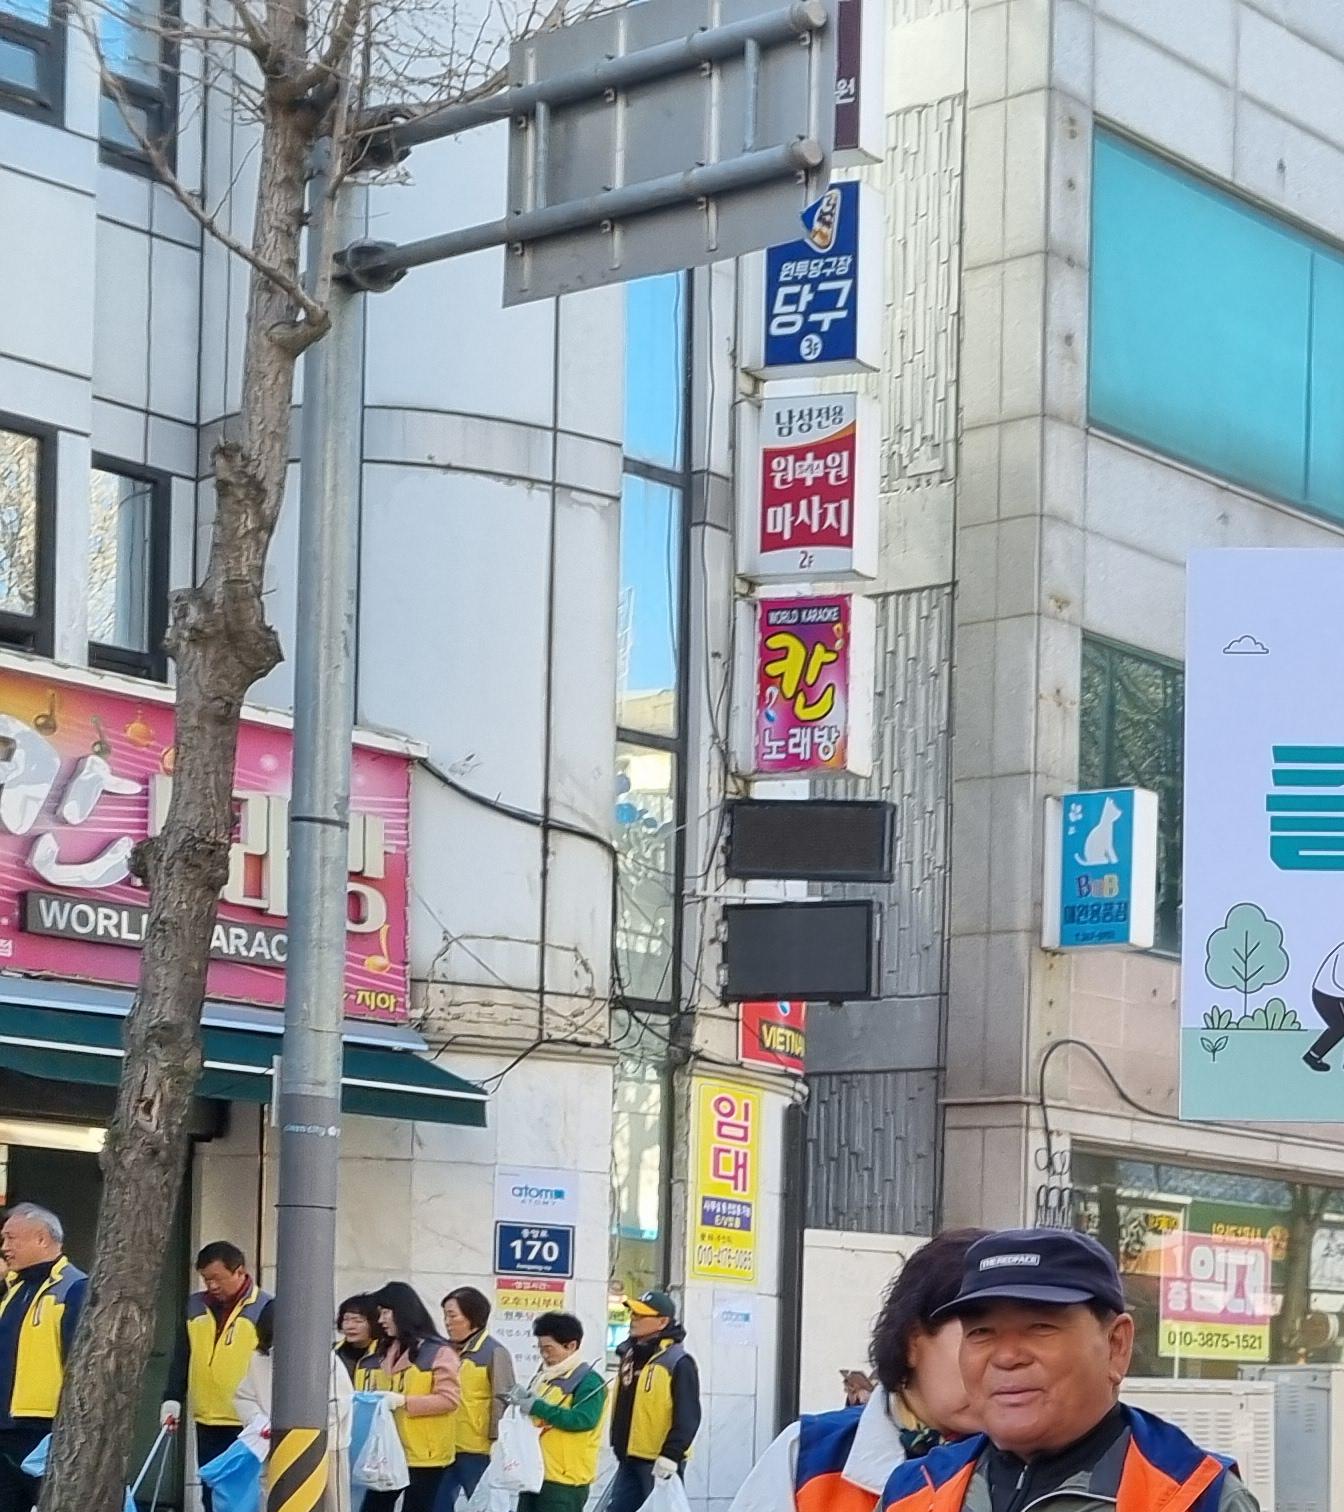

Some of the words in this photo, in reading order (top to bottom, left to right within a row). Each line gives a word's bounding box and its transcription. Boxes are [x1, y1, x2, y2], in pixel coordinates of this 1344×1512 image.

[779, 256, 851, 282] 원투당구장
[769, 279, 853, 336] 당구
[775, 404, 845, 437] 남성전용
[766, 495, 850, 541] 마사지
[799, 550, 815, 569] 2F
[767, 610, 798, 625] WORLD
[765, 631, 838, 721] 칸
[762, 726, 840, 763] 노래방
[38, 898, 151, 942] WORL
[712, 1095, 751, 1194] 임대
[510, 1240, 559, 1263] 170
[1167, 1323, 1263, 1350] 010-3875-1521
